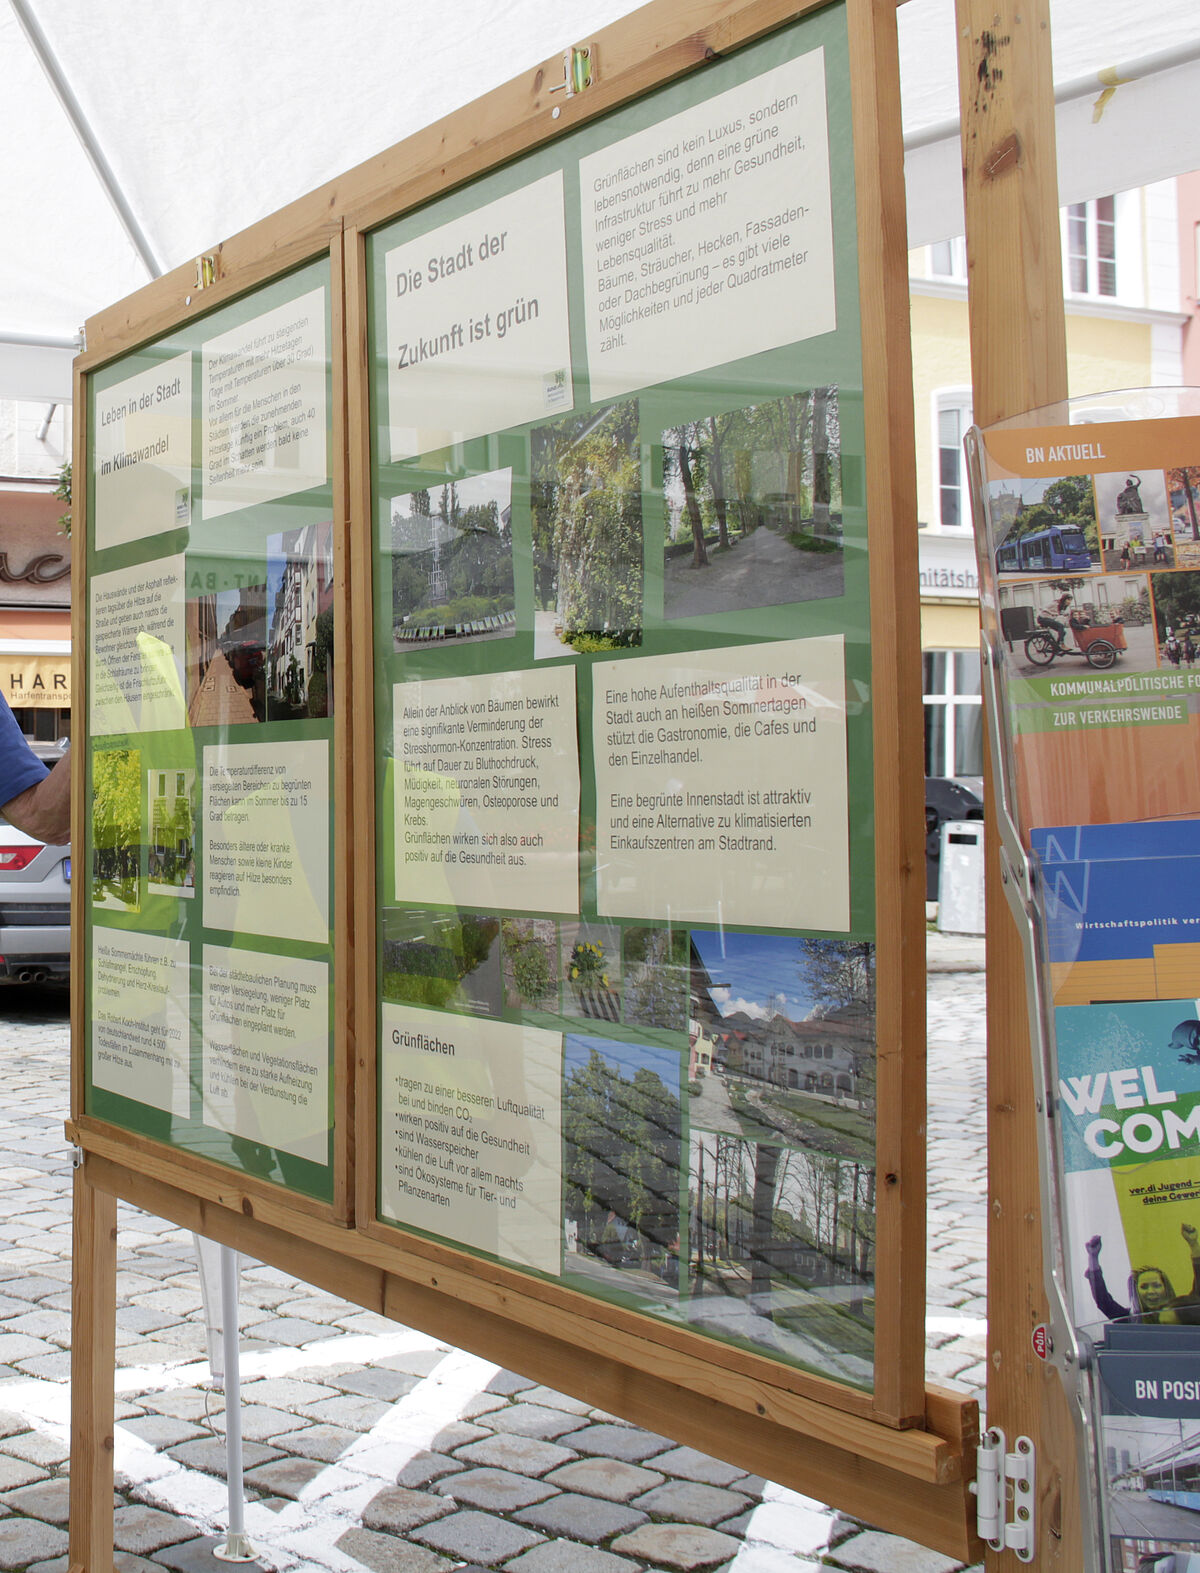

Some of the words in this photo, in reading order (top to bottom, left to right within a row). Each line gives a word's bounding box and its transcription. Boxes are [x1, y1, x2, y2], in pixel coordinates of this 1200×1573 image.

[593, 158, 654, 192] Grünflächen
[656, 143, 680, 165] sind
[682, 135, 705, 154] kein
[708, 119, 745, 143] Luxus,
[748, 94, 798, 125] sondern
[594, 168, 683, 212] lebensnotwendig,
[686, 153, 714, 174] denn
[717, 141, 742, 161] eine
[744, 125, 779, 153] grüne
[595, 199, 656, 232] Infrastruktur
[658, 185, 684, 207] führt
[685, 181, 700, 197] zu
[702, 167, 731, 189] mehr
[734, 135, 805, 175] Gesundheit,
[595, 227, 636, 252] weniger
[638, 214, 672, 236] Stress
[675, 200, 696, 222] und
[698, 191, 727, 212] mehr
[396, 269, 422, 297] Die
[427, 244, 473, 283] Stadt
[478, 231, 507, 261] der
[398, 324, 464, 369] Zukunft
[469, 313, 491, 343] ist
[496, 297, 539, 338] grün
[101, 404, 127, 427] Leben
[128, 398, 137, 415] in
[138, 392, 154, 410] der
[156, 378, 181, 403] Stadt
[100, 459, 111, 476] im
[113, 434, 169, 471] Klimawandel
[1026, 447, 1045, 464] BN
[1048, 443, 1106, 462] AKTUELL
[919, 568, 979, 588] nitätsh
[10, 674, 67, 690] HAR
[605, 689, 628, 704] Eine
[630, 686, 657, 702] hohe
[659, 676, 763, 699] Aufenthaltsqualität
[766, 673, 777, 689] in
[780, 672, 802, 688] der
[1050, 676, 1183, 697] KOMMUNALPOLITISCHE
[402, 705, 424, 720] Allein
[424, 704, 438, 718] der
[439, 702, 468, 716] Anblick
[469, 703, 486, 714] von
[487, 699, 524, 713] Bäumen
[525, 694, 559, 710] bewirkt
[606, 709, 634, 725] Stadt
[635, 707, 662, 723] auch
[664, 708, 679, 721] an
[681, 702, 720, 719] heißen
[722, 697, 806, 716] Sommertagen
[1053, 710, 1076, 726] ZUR
[1079, 706, 1182, 724] VERKEHRSWENDE
[606, 730, 636, 746] stützt
[637, 729, 654, 744] die
[656, 724, 730, 742] Gastronomie,
[734, 721, 751, 738] die
[753, 719, 789, 736] Cafes
[792, 717, 816, 734] und
[608, 752, 628, 767] den
[630, 748, 702, 765] Einzelhandel.
[610, 793, 633, 808] Eine
[635, 792, 683, 811] begrünte
[686, 790, 744, 806] Innenstadt
[747, 790, 760, 805] ist
[762, 788, 811, 805] attraktiv
[610, 814, 629, 829] und
[631, 814, 654, 829] eine
[656, 813, 715, 828] Alternative
[717, 816, 731, 828] zu
[734, 812, 811, 828] klimatisierten
[610, 834, 694, 850] Einkaufszentren
[697, 838, 715, 850] am
[718, 834, 776, 851] Stadtrand.
[1076, 917, 1178, 929] Wirtschaftspolitik
[391, 1029, 455, 1055] Grünflächen
[398, 1075, 422, 1092] tragen
[423, 1082, 434, 1094] zu
[434, 1084, 455, 1099] einer
[456, 1088, 494, 1108] besseren
[496, 1096, 544, 1120] Luftqualität
[1059, 1066, 1178, 1116] WEL
[1129, 1184, 1156, 1194] ver.di
[1158, 1179, 1192, 1191] Jugend
[1143, 1195, 1167, 1204] deine
[1135, 1380, 1158, 1399] BN
[1162, 1380, 1200, 1400] POSI
